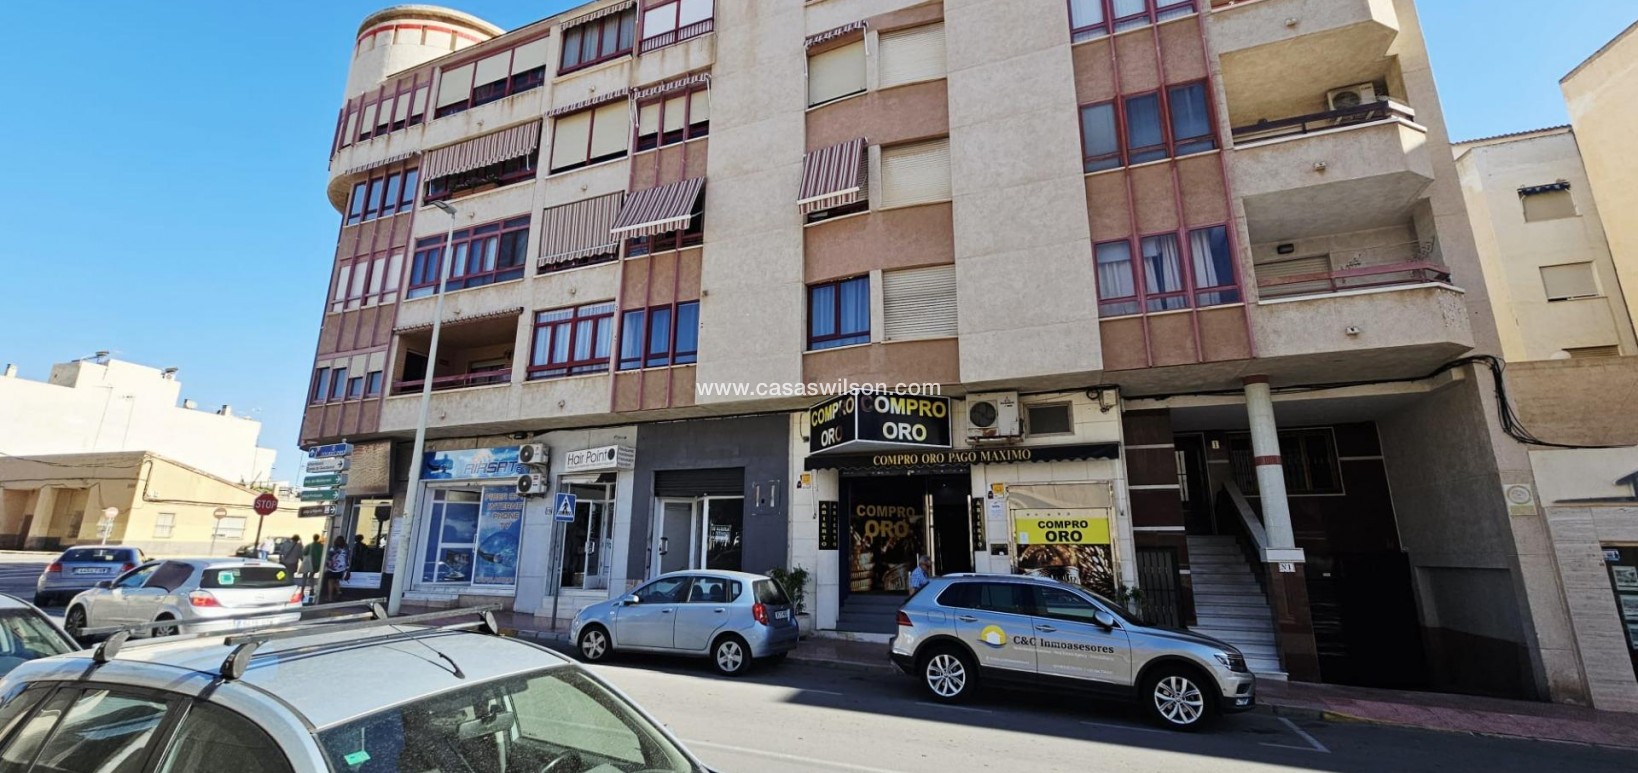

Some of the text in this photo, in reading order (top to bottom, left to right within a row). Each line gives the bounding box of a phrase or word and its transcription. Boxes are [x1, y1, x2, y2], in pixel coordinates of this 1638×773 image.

[811, 396, 855, 427] COMPRO
[860, 395, 947, 418] COMPRO
[820, 425, 843, 447] ORO
[882, 421, 928, 442] ORO
[568, 452, 585, 465] Hair
[586, 449, 608, 463] Point
[873, 449, 1031, 466] COMPRO ORO PAGO MAXIMO
[255, 499, 277, 509] STOP
[856, 504, 916, 518] COMPRO
[865, 520, 909, 538] ORO
[1038, 520, 1088, 529] COMPRO
[1045, 530, 1083, 542] ORO
[1013, 636, 1037, 647] C&C
[1040, 638, 1115, 654] Inmoasesores
